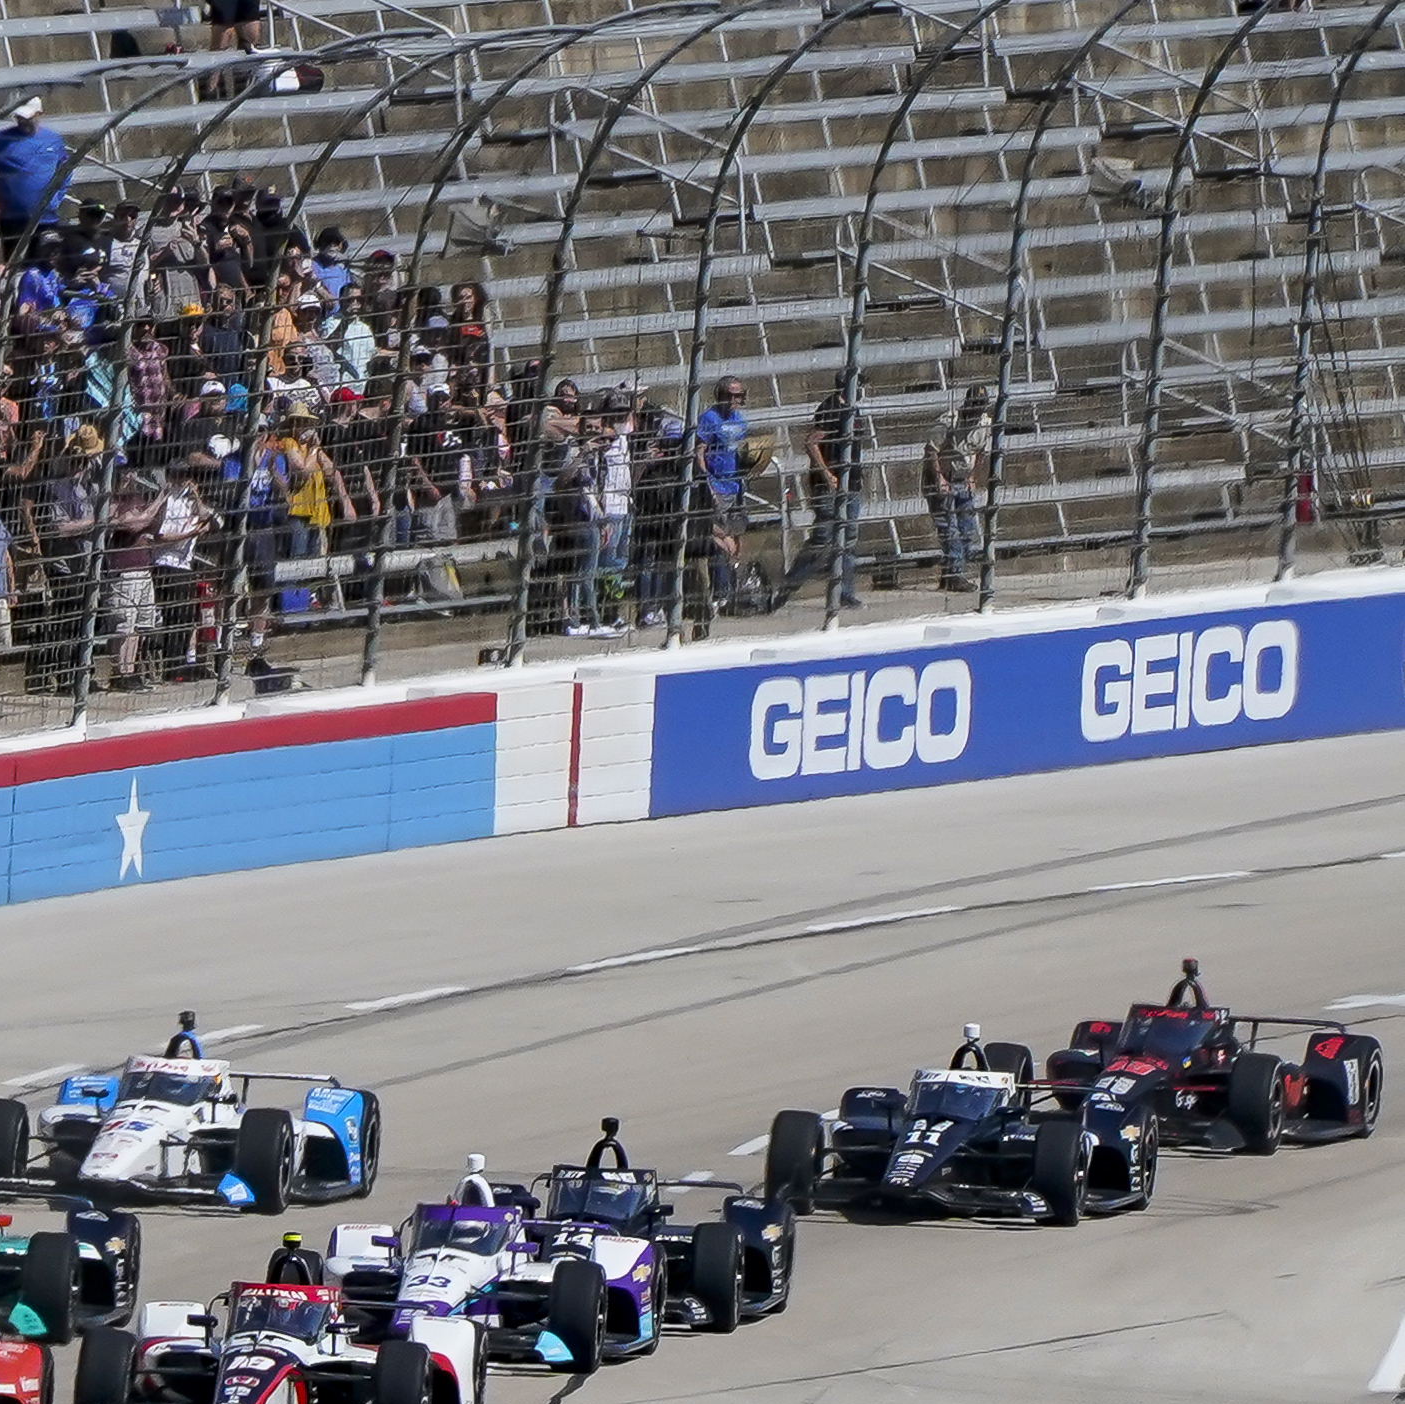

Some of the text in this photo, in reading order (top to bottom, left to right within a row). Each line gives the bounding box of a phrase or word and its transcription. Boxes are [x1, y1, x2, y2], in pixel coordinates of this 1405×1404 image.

[749, 657, 972, 781] GEICO
[1081, 618, 1298, 743] GEICO
[905, 1131, 942, 1146] 11
